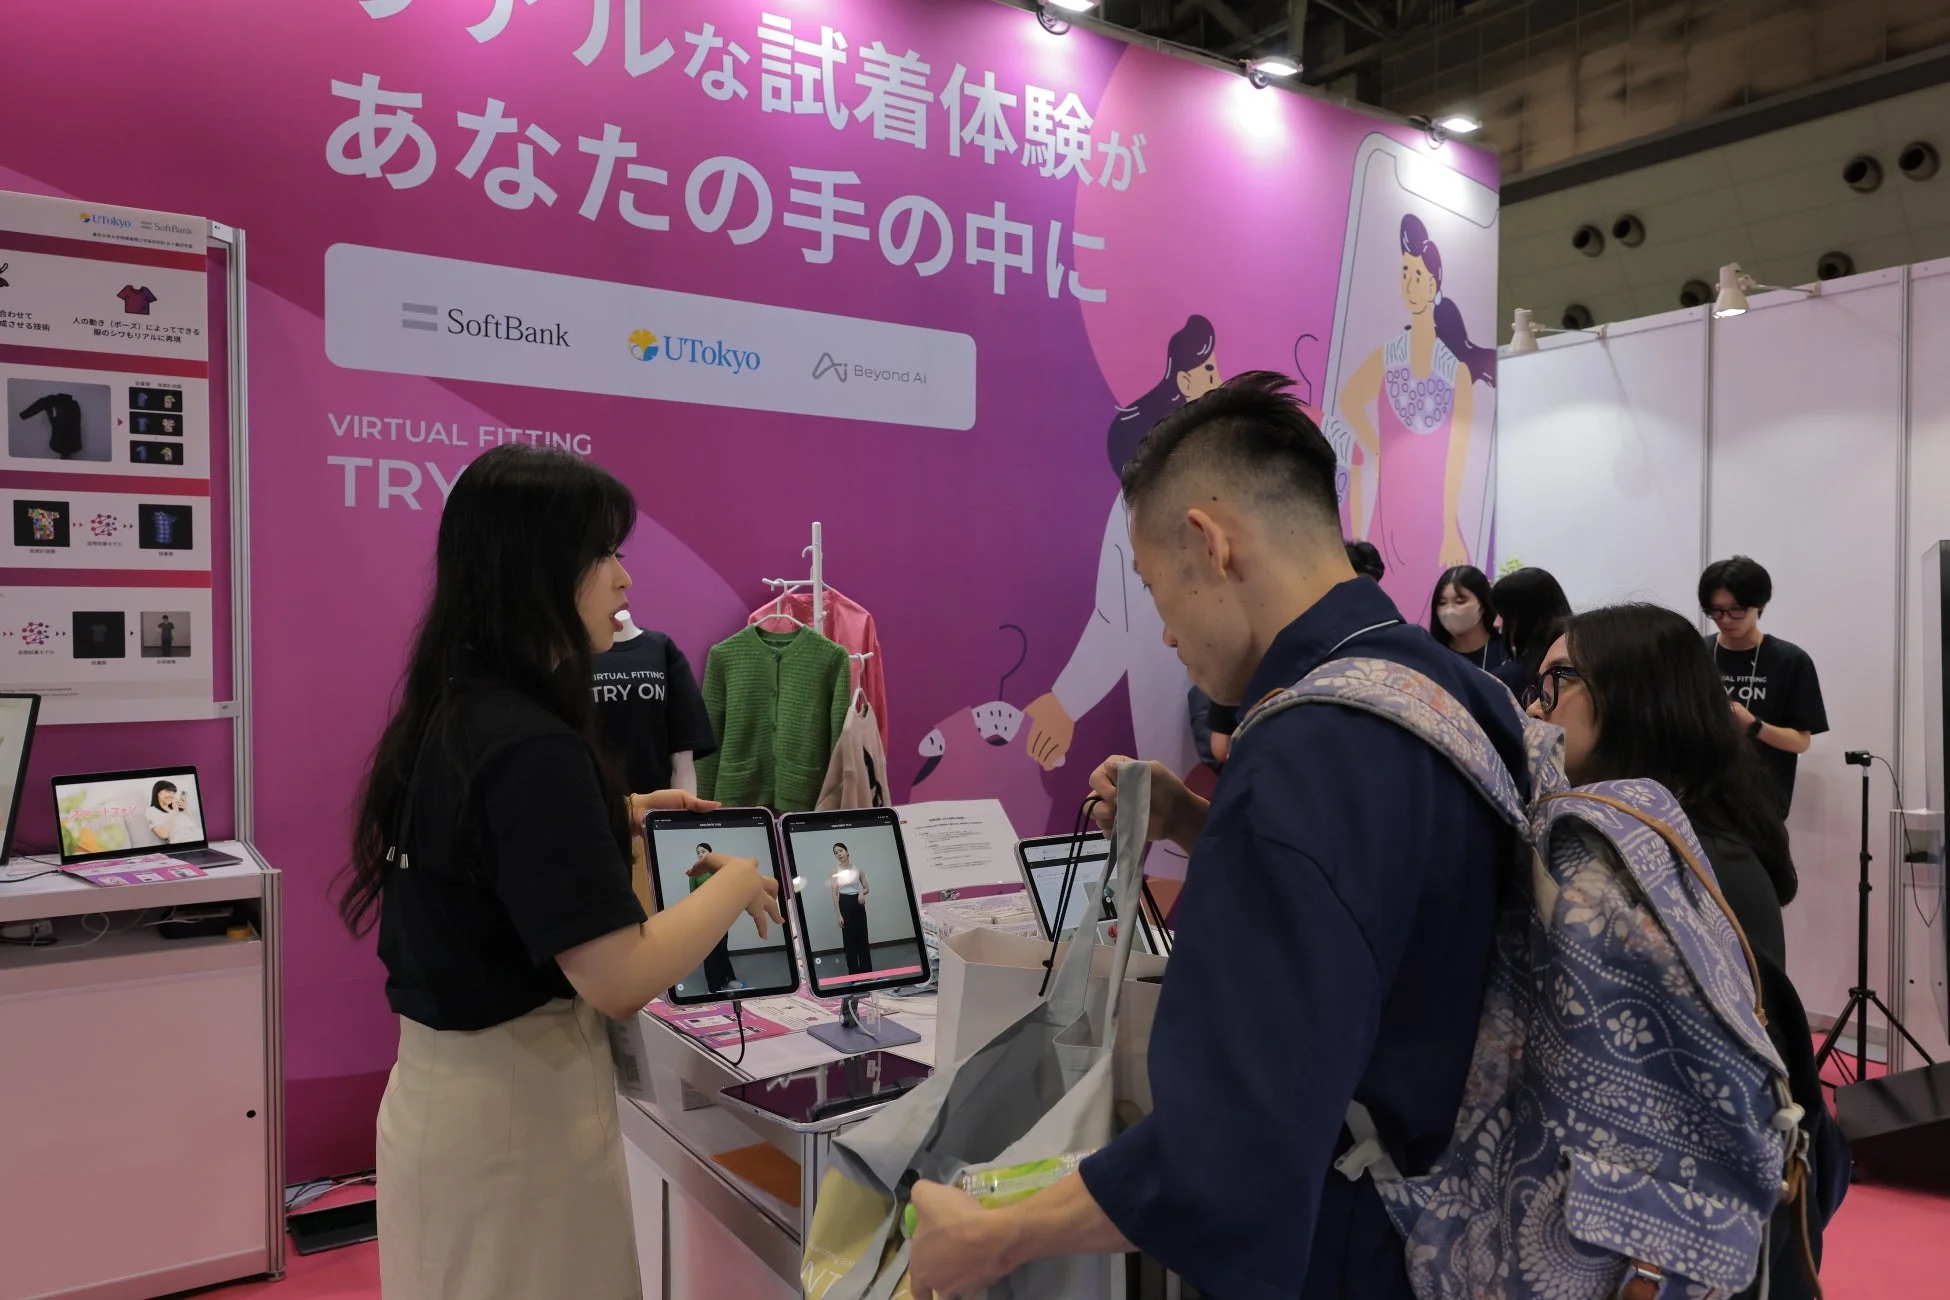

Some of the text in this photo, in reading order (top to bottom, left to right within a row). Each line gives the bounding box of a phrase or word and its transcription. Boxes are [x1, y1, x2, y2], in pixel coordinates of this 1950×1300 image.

[358, 0, 1148, 191] ルな試着体験が
[325, 73, 1107, 303] あなたの手の中に
[92, 214, 132, 229] UTokyo
[154, 222, 193, 235] SoftBank
[446, 308, 570, 348] SoftBank
[663, 335, 761, 375] UTokyo
[854, 364, 927, 384] Beyond AI
[328, 413, 592, 456] VIRTUAL FITTING
[327, 455, 469, 511] TRY
[594, 671, 664, 680] IRTUAL FITTING
[593, 683, 665, 702] TRY ON
[1739, 687, 1766, 700] ON
